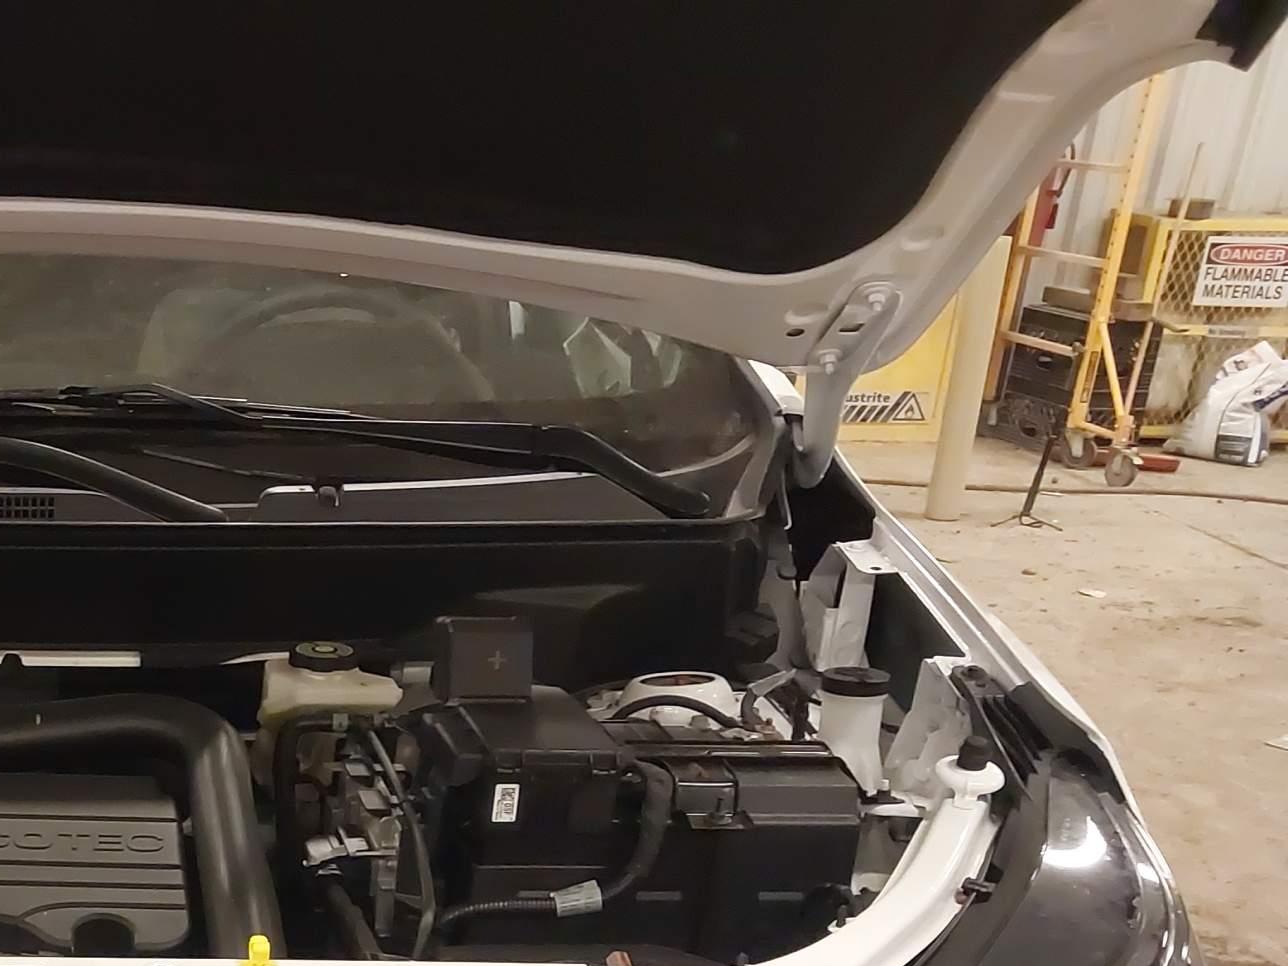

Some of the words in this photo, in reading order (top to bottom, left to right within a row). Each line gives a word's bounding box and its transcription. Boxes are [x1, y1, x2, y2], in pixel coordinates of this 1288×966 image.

[1219, 248, 1286, 261] DANGER
[1204, 266, 1288, 282] FLAMMABLE
[1202, 284, 1283, 300] MATERIALS
[846, 391, 890, 403] ustrite
